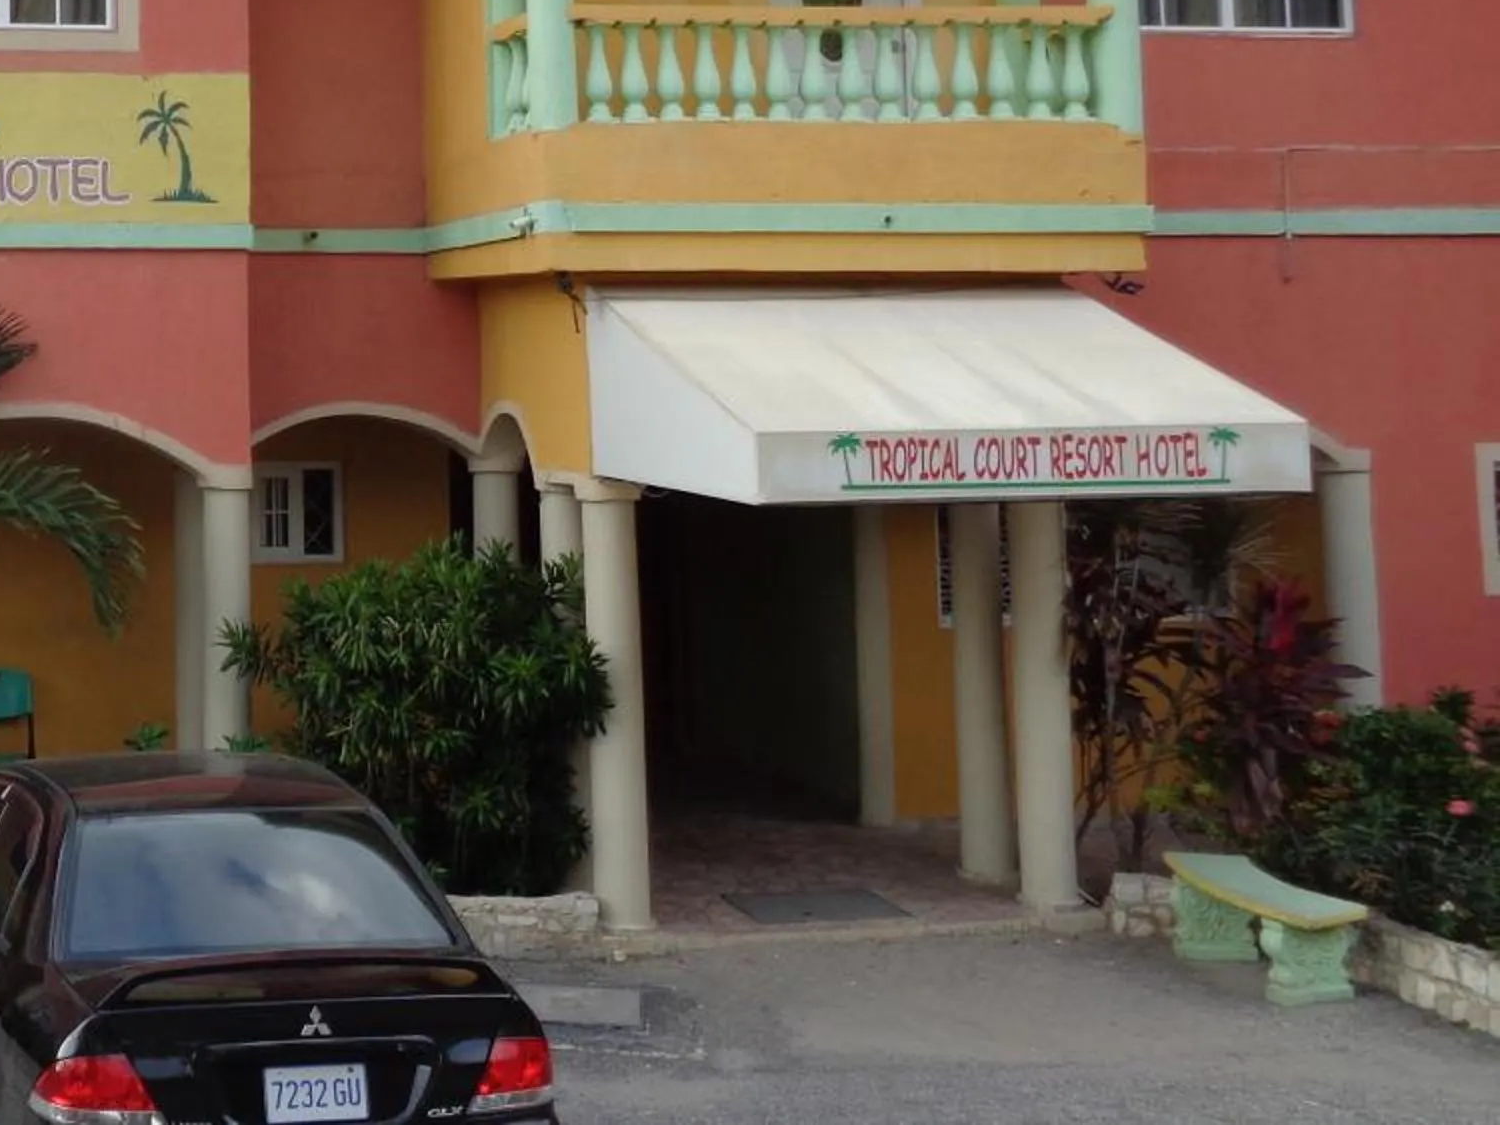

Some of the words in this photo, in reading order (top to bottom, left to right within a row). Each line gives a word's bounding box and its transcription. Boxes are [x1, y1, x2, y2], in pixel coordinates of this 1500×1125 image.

[865, 437, 966, 482] TROPICAL
[973, 436, 1041, 480] COURT
[1049, 434, 1127, 479] RESORT
[1135, 432, 1207, 477] HOTEL
[271, 1079, 328, 1110] 7232
